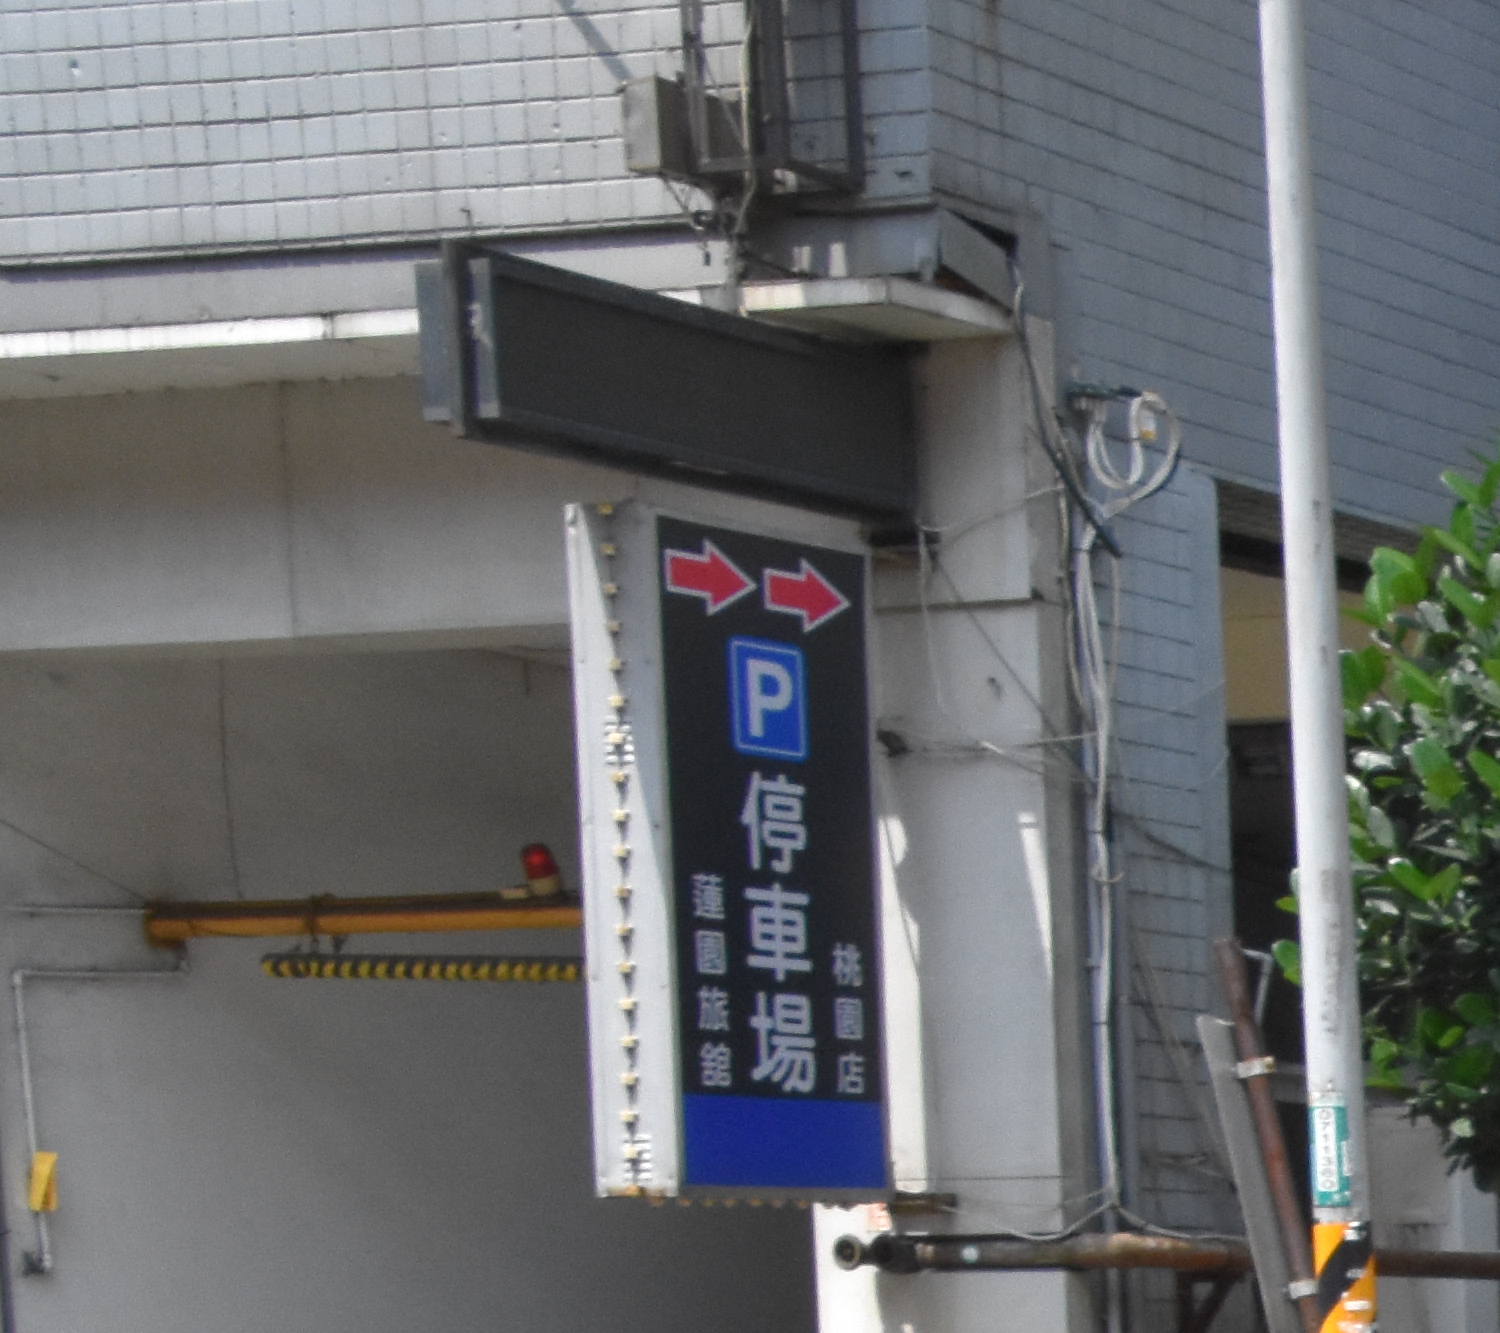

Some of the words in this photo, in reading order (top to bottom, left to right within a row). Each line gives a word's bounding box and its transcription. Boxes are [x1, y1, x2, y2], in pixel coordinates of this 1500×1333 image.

[746, 659, 794, 739] P
[740, 770, 816, 1094] 停車場
[832, 941, 867, 1095] 桃園店
